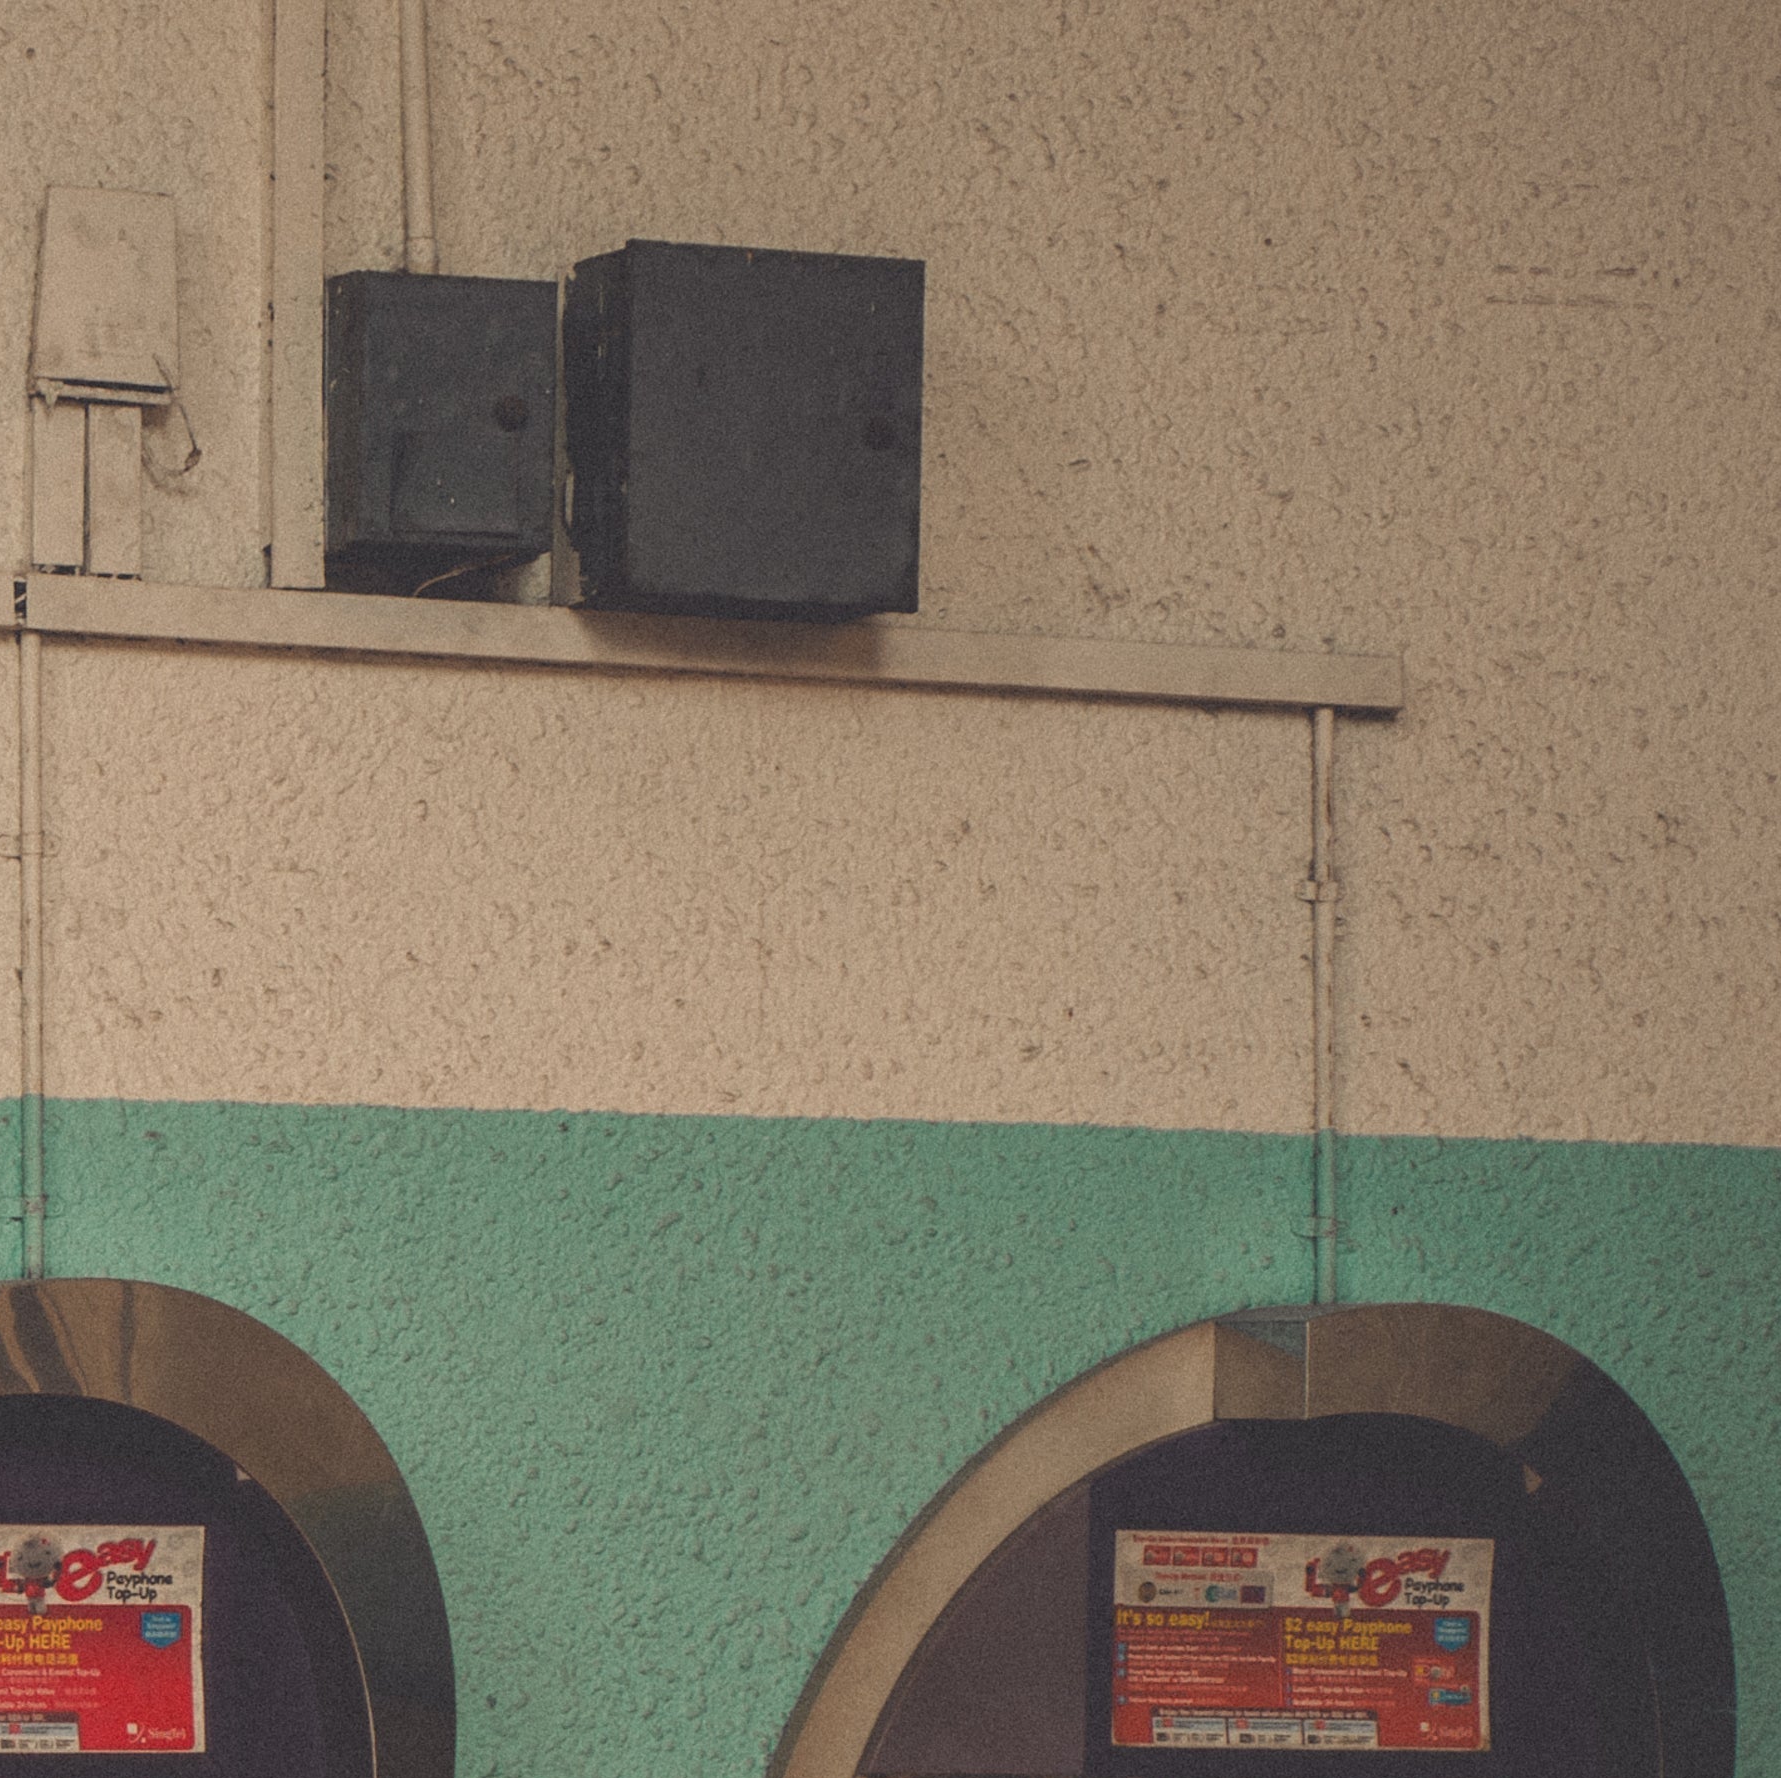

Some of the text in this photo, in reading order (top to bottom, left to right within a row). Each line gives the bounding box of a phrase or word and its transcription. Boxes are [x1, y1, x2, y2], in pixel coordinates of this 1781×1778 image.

[55, 1537, 157, 1602] easy
[106, 1571, 173, 1589] Payphone
[106, 1586, 157, 1605] Top-Up
[1404, 1593, 1450, 1609] Top-Up
[32, 1615, 103, 1635] Payphone
[1117, 1608, 1210, 1630] It's so easy!
[1306, 1620, 1339, 1636] easy
[1343, 1618, 1413, 1636] Payphone
[29, 1634, 71, 1650] HERE
[1285, 1635, 1380, 1651] Top-Up HERE
